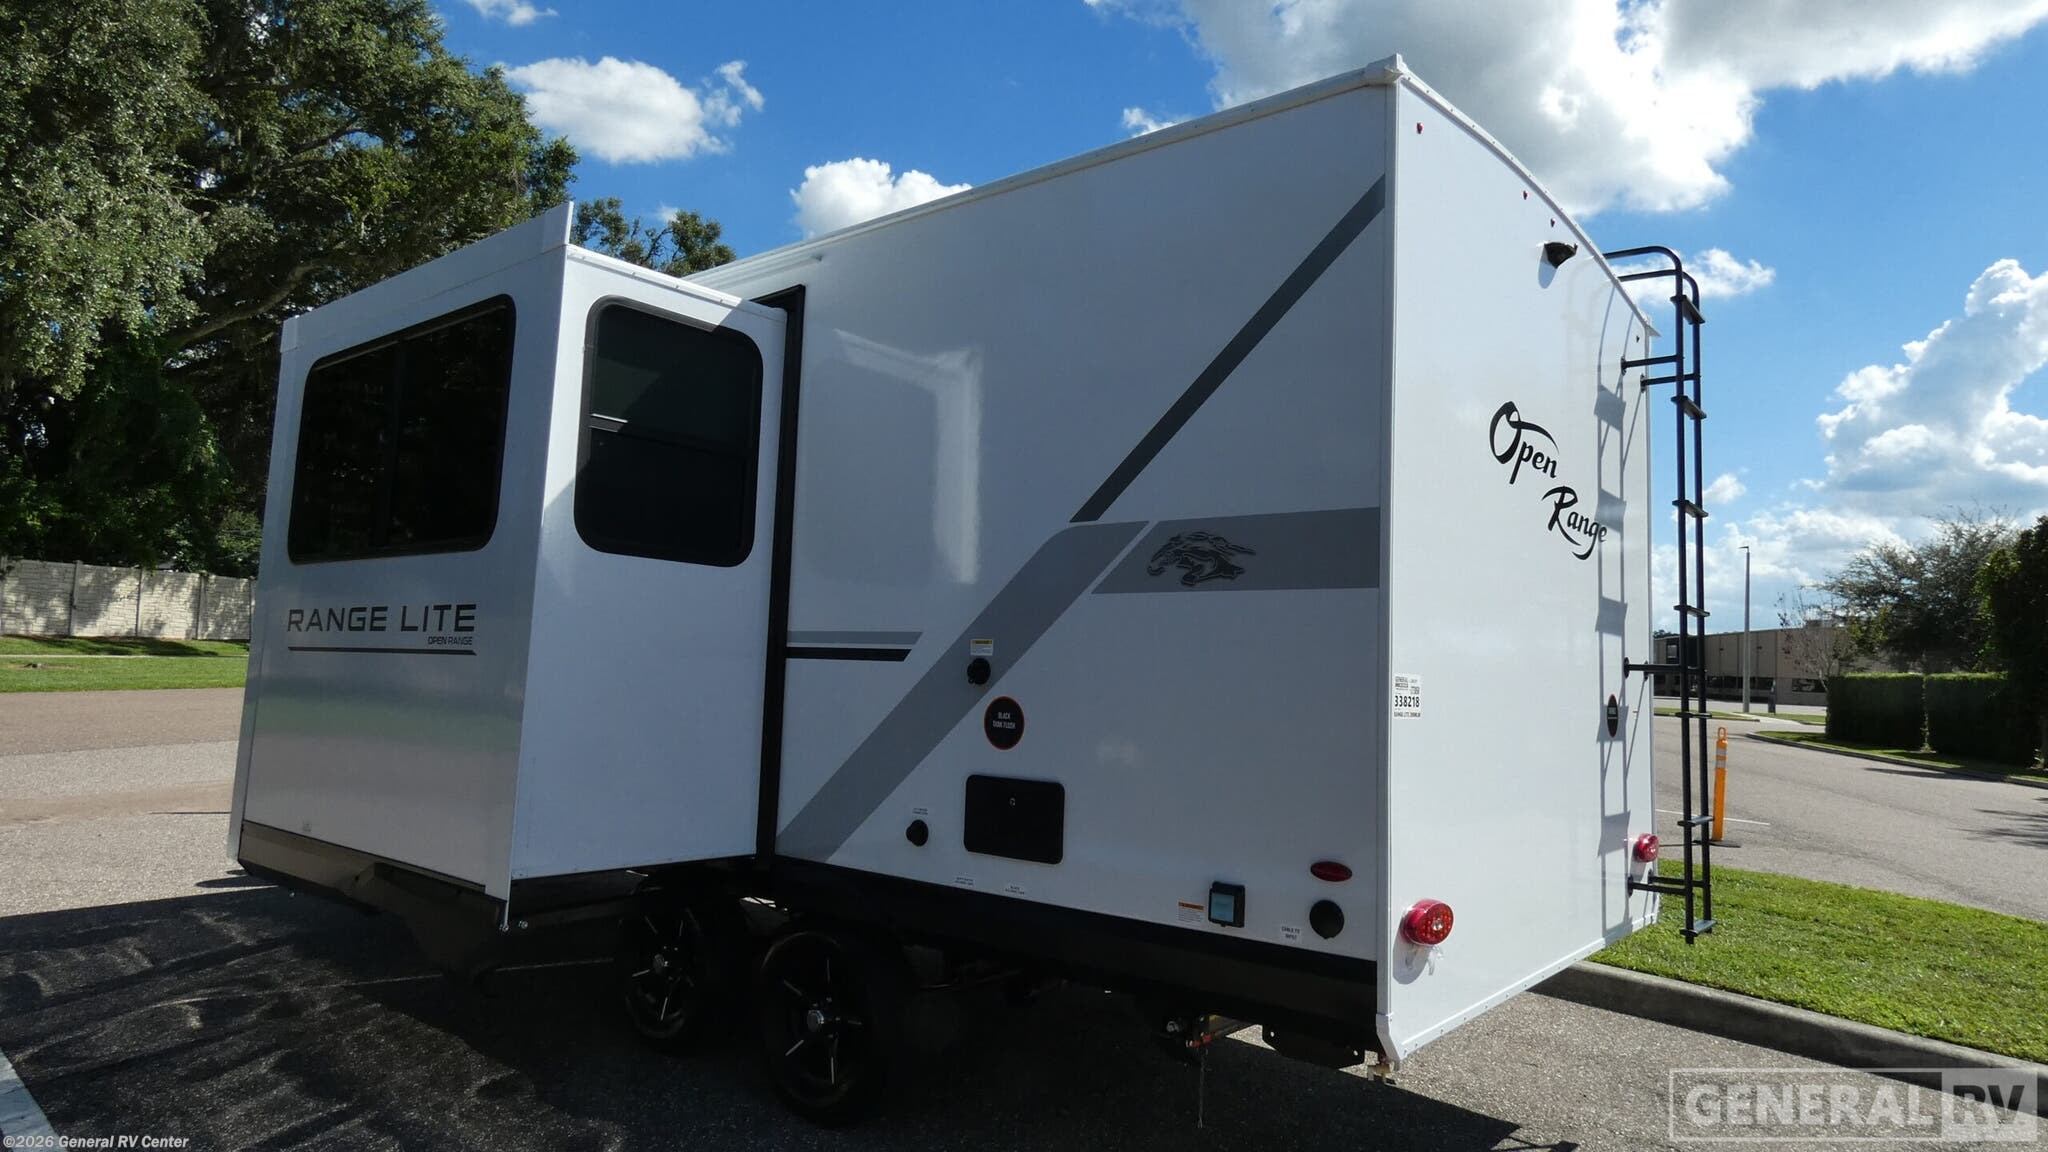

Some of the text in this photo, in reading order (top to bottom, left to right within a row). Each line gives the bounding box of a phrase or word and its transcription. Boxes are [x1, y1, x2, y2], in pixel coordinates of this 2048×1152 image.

[1489, 401, 1559, 485] Open
[1541, 486, 1608, 560] Range
[287, 603, 477, 632] RANGE LITE
[427, 636, 473, 646] OPEN RANGE
[1394, 695, 1420, 708] 338218
